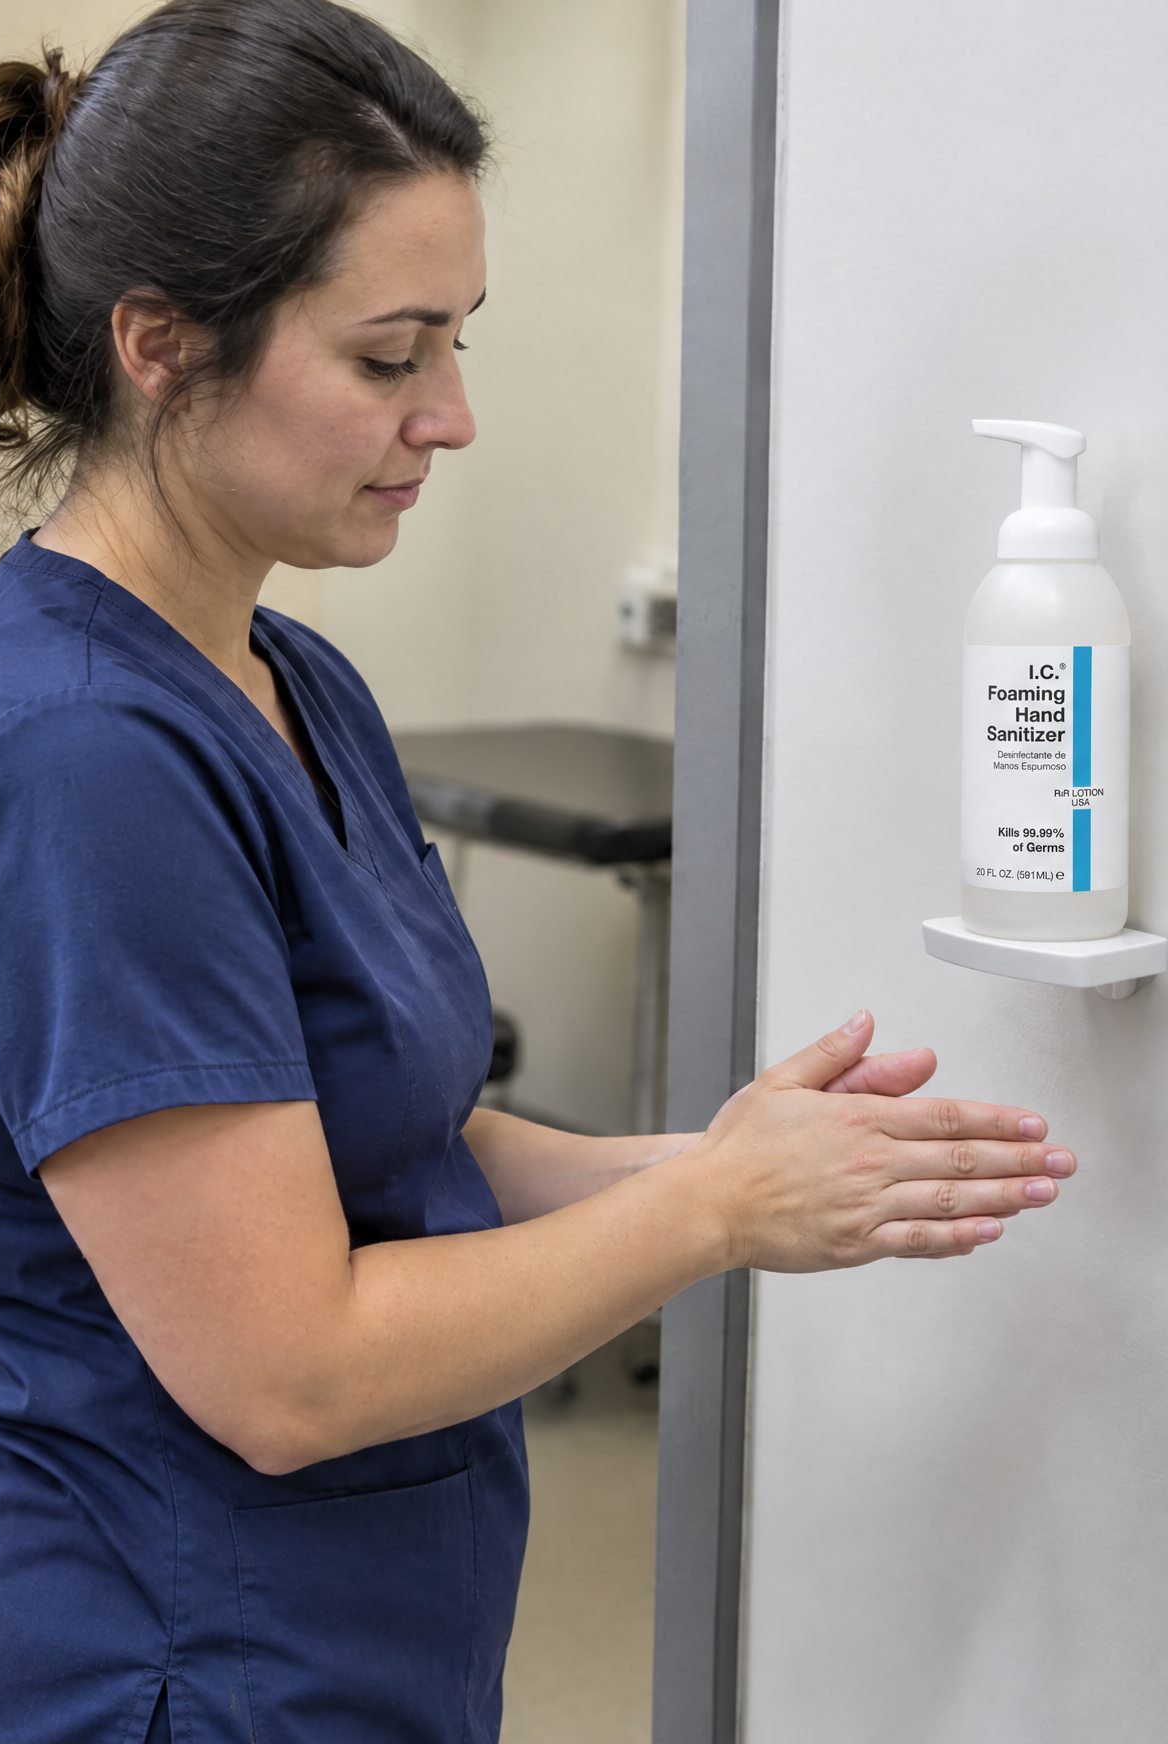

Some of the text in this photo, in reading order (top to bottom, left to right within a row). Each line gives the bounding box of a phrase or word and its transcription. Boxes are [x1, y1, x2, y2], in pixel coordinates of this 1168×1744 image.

[988, 685, 1065, 704] Foaming
[1015, 707, 1065, 722] Hand
[987, 725, 1066, 742] Sanitizer
[997, 750, 1066, 759] Desinfectante de
[993, 761, 1019, 770] Manos
[1072, 788, 1104, 798] LOTION
[1071, 798, 1090, 807] USA
[998, 827, 1065, 838] Kills 99.99%
[1012, 842, 1065, 852] of Germs
[976, 867, 985, 876] 20
[986, 868, 997, 877] FL
[998, 869, 1014, 879] OZ.
